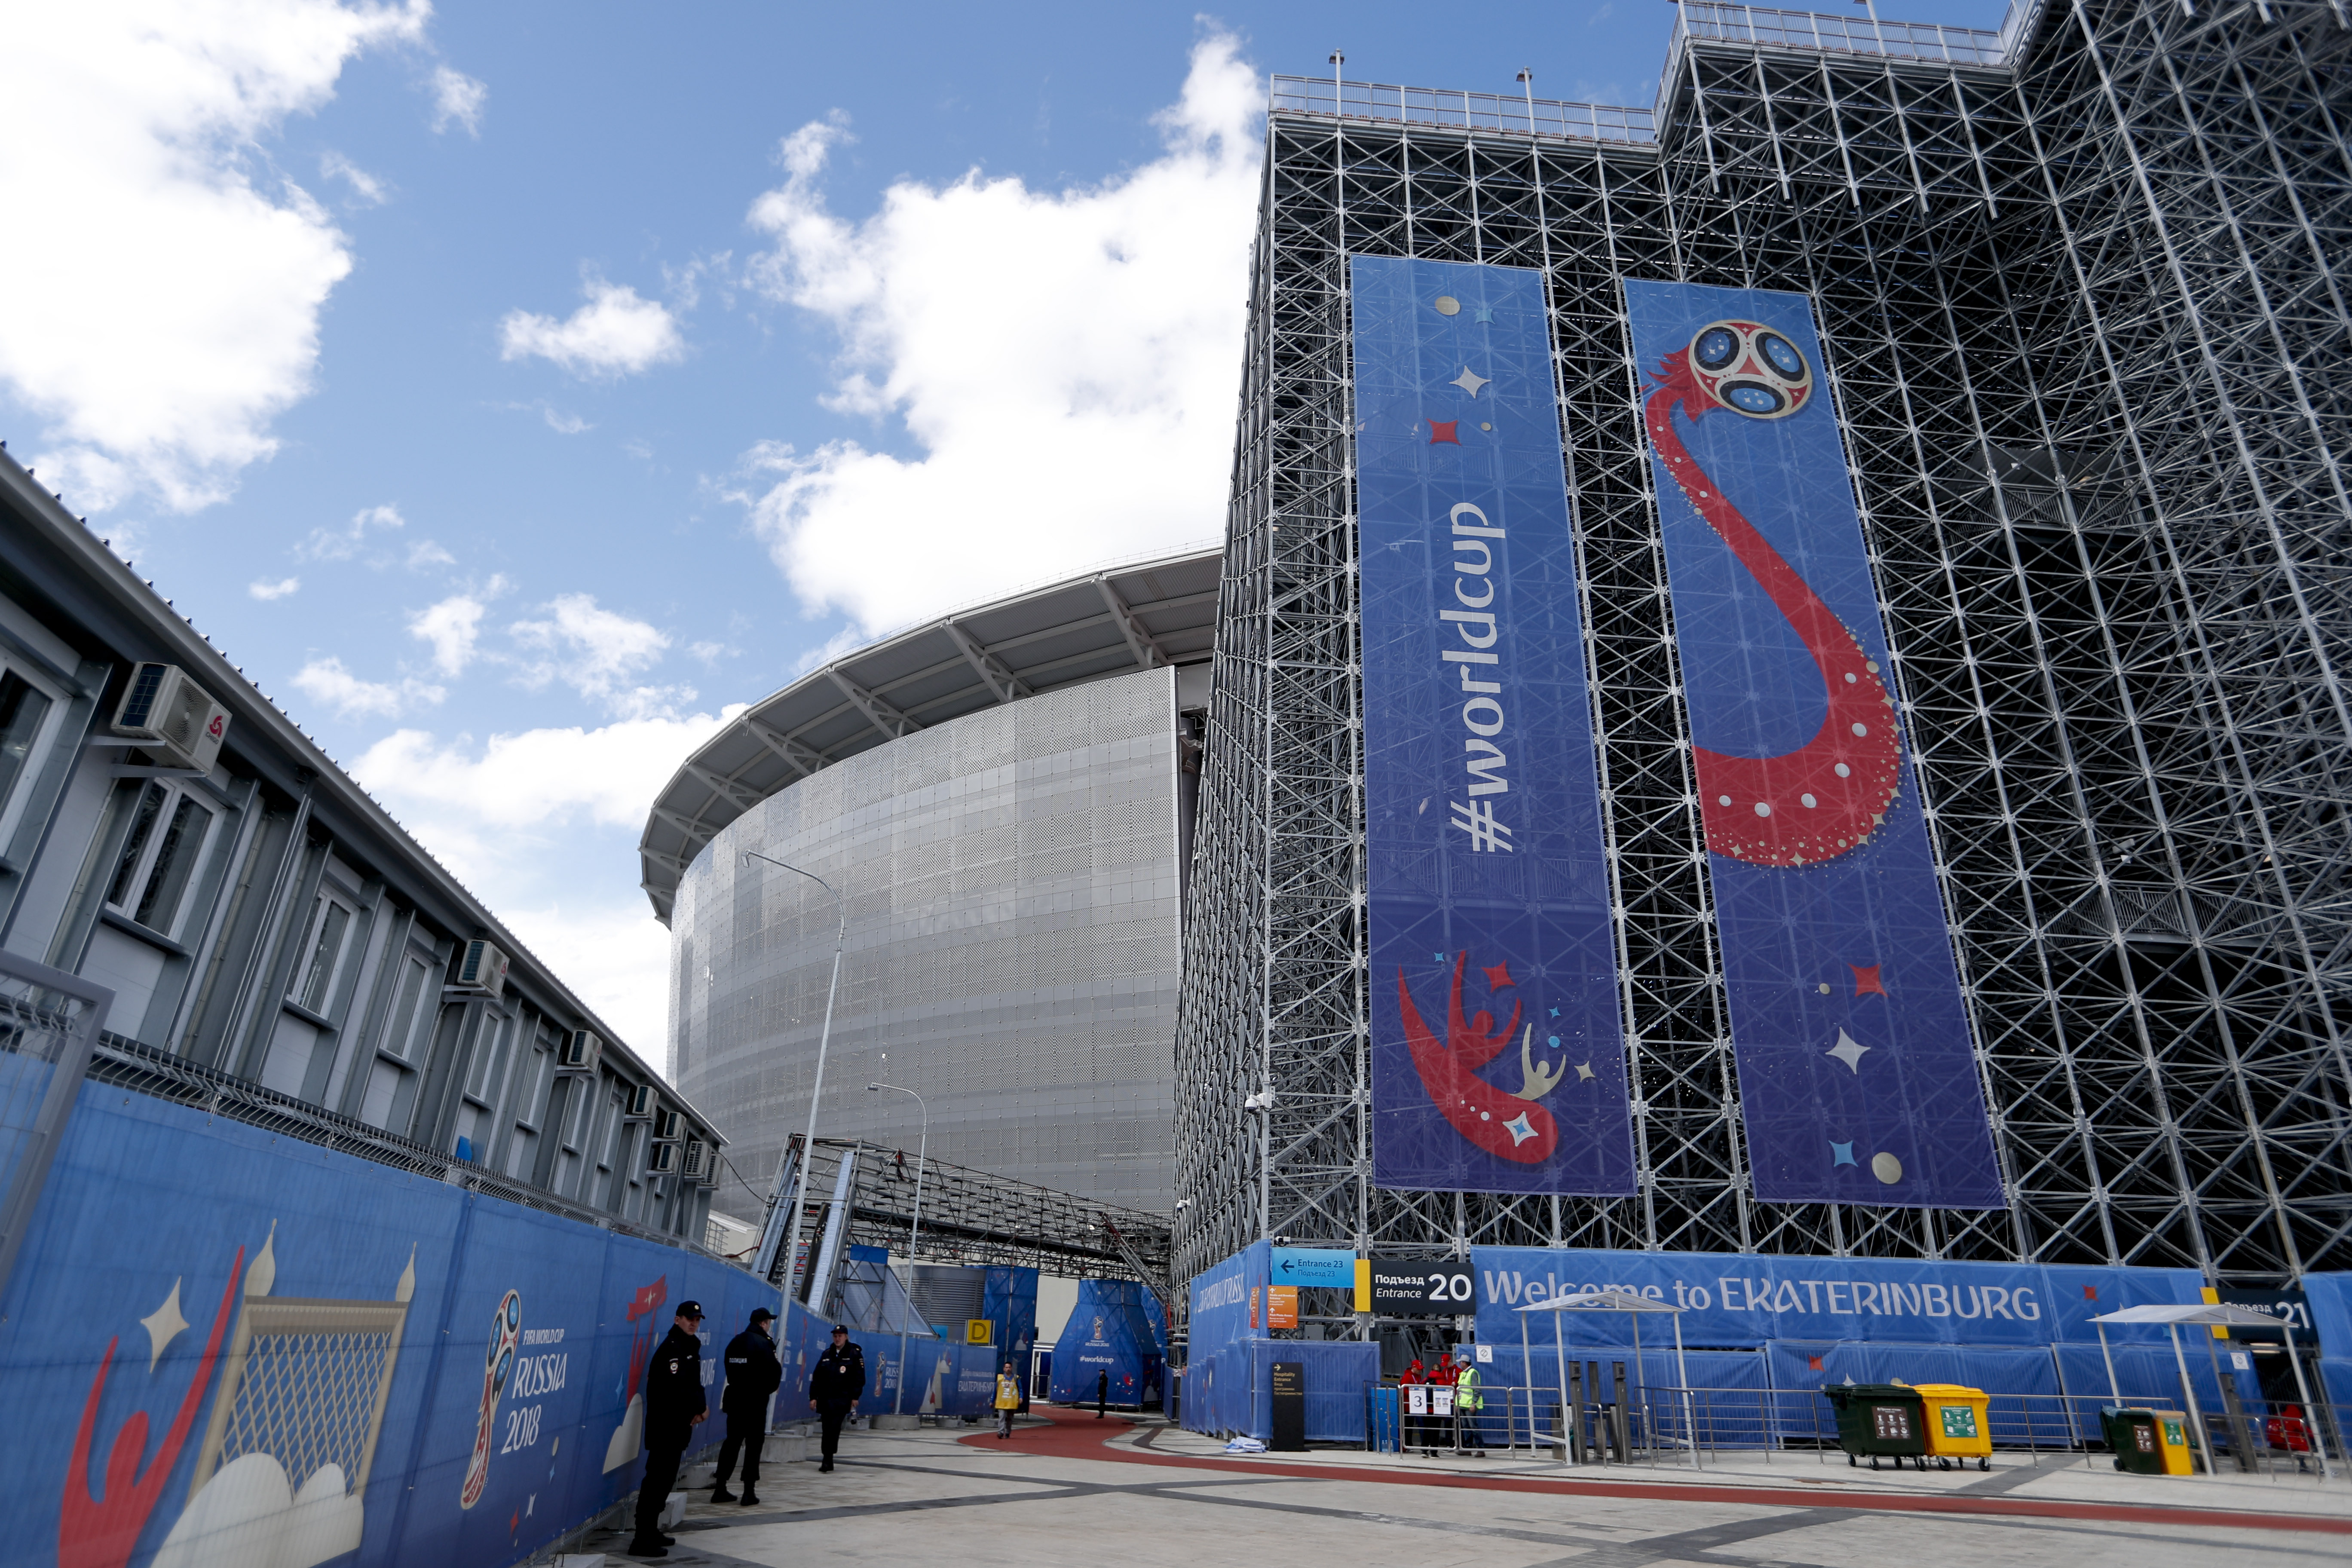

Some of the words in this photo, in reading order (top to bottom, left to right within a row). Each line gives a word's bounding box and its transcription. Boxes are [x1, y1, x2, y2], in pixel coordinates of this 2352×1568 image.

[1439, 502, 1513, 853] #worldcup
[206, 732, 219, 744] CHIGO
[1298, 1259, 1332, 1268] Entrance
[1298, 1269, 1326, 1277] Подъезд
[1375, 1274, 1424, 1286] Подъезд
[1376, 1288, 1422, 1298] Entrance
[1428, 1273, 1472, 1302] 20
[1672, 1280, 1711, 1310] to
[1718, 1277, 2040, 1321] EKATERINBURG
[2275, 1302, 2310, 1329] 21
[523, 1329, 536, 1345] FIFA
[535, 1329, 555, 1344] WORLD
[554, 1328, 564, 1343] CUP
[971, 1322, 987, 1340] D
[1079, 1355, 1115, 1365] #worldcup
[512, 1353, 567, 1399] RUSSIA
[1414, 1395, 1422, 1407] 3
[501, 1404, 542, 1455] 2018
